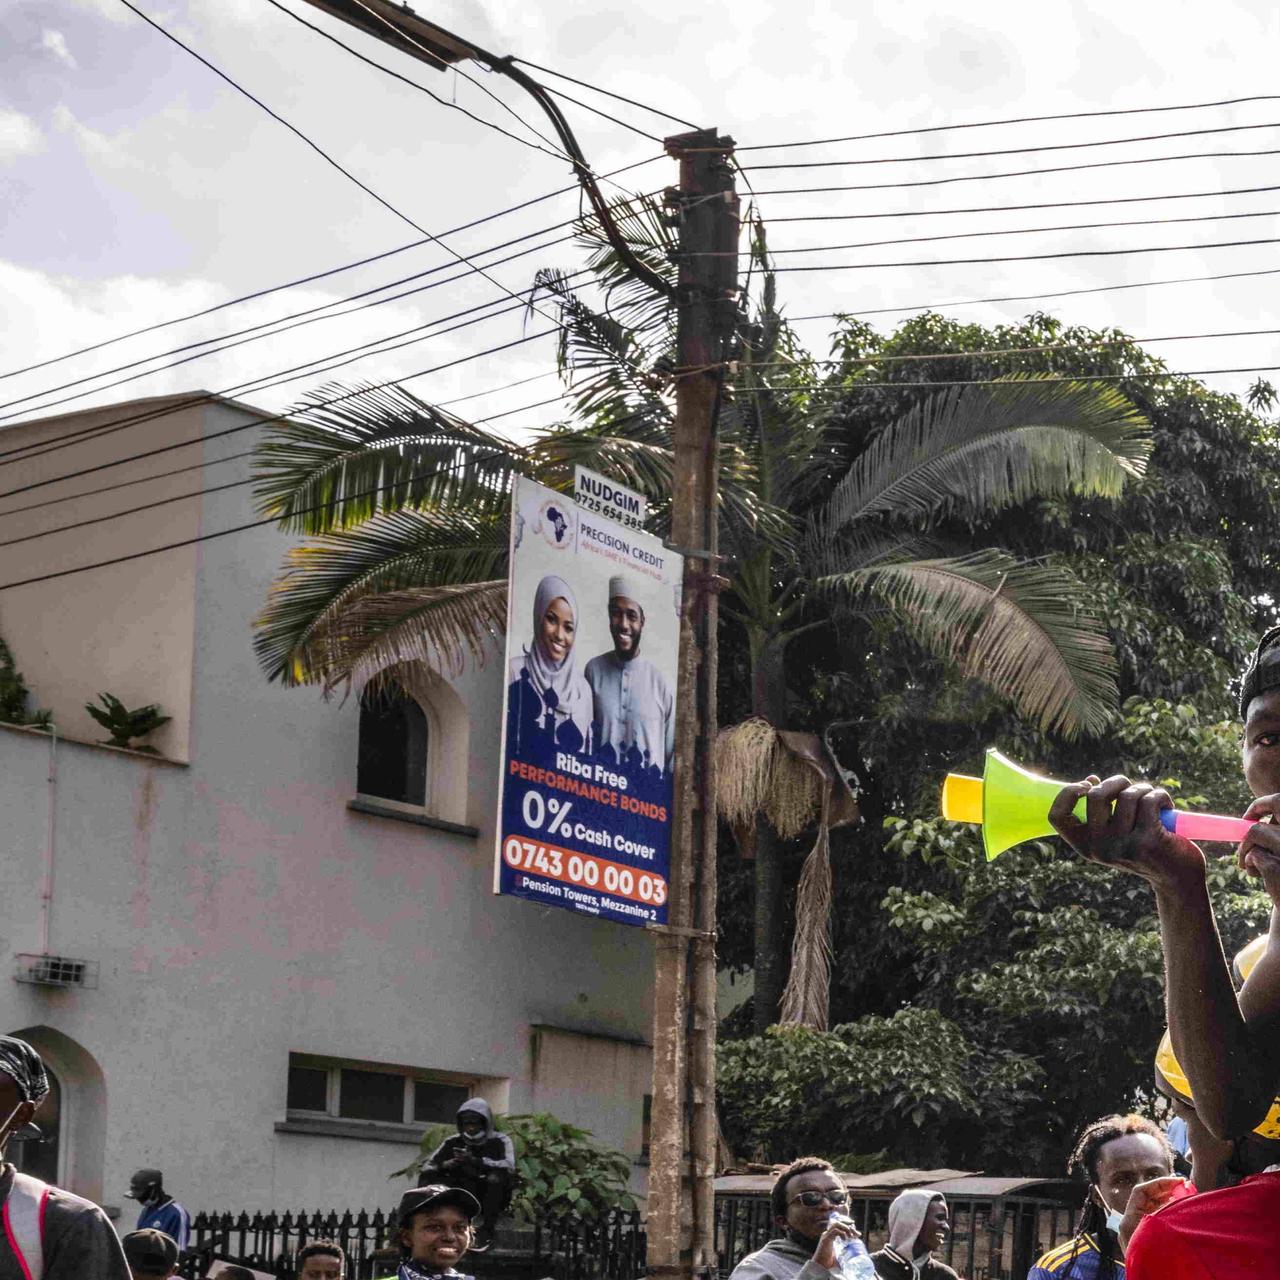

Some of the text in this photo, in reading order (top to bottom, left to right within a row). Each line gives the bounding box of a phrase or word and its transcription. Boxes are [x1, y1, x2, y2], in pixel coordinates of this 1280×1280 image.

[574, 491, 643, 531] 0725 654 385
[580, 474, 640, 516] NUDGIM
[580, 523, 630, 554] PRECISION
[632, 547, 664, 569] CREDIT
[510, 760, 667, 822] PERFORMANCE BONDS
[556, 752, 628, 790] Riba Free
[522, 790, 656, 860] 0% Cash Cover
[506, 839, 667, 904] 0743 00 00 03
[522, 876, 657, 921] Pension Towers, Mezzanine 2
